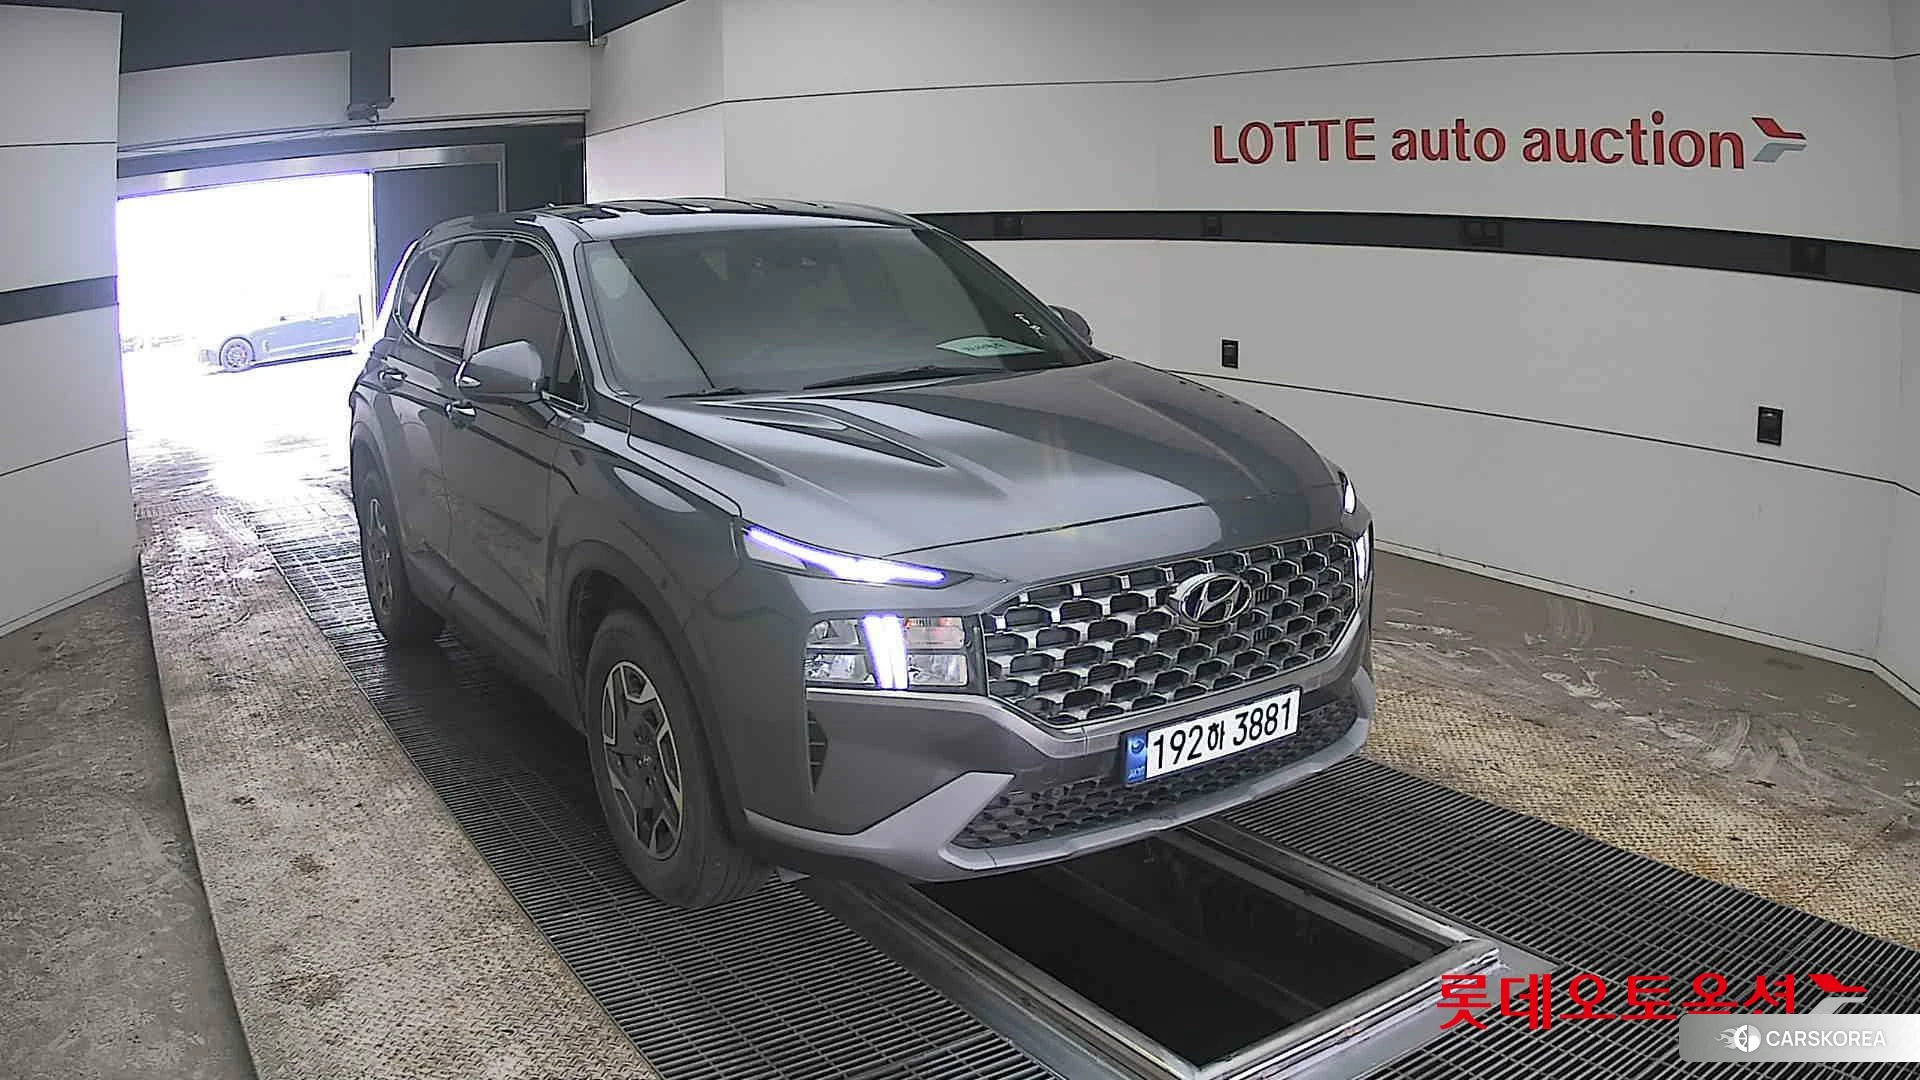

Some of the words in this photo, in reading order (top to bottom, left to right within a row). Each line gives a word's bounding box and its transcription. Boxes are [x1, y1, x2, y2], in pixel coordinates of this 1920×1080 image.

[1212, 117, 1377, 165] LOTTE
[1391, 117, 1507, 162] auto
[1521, 110, 1746, 170] auction
[1152, 721, 1226, 770] 192하
[1232, 697, 1292, 747] 3881
